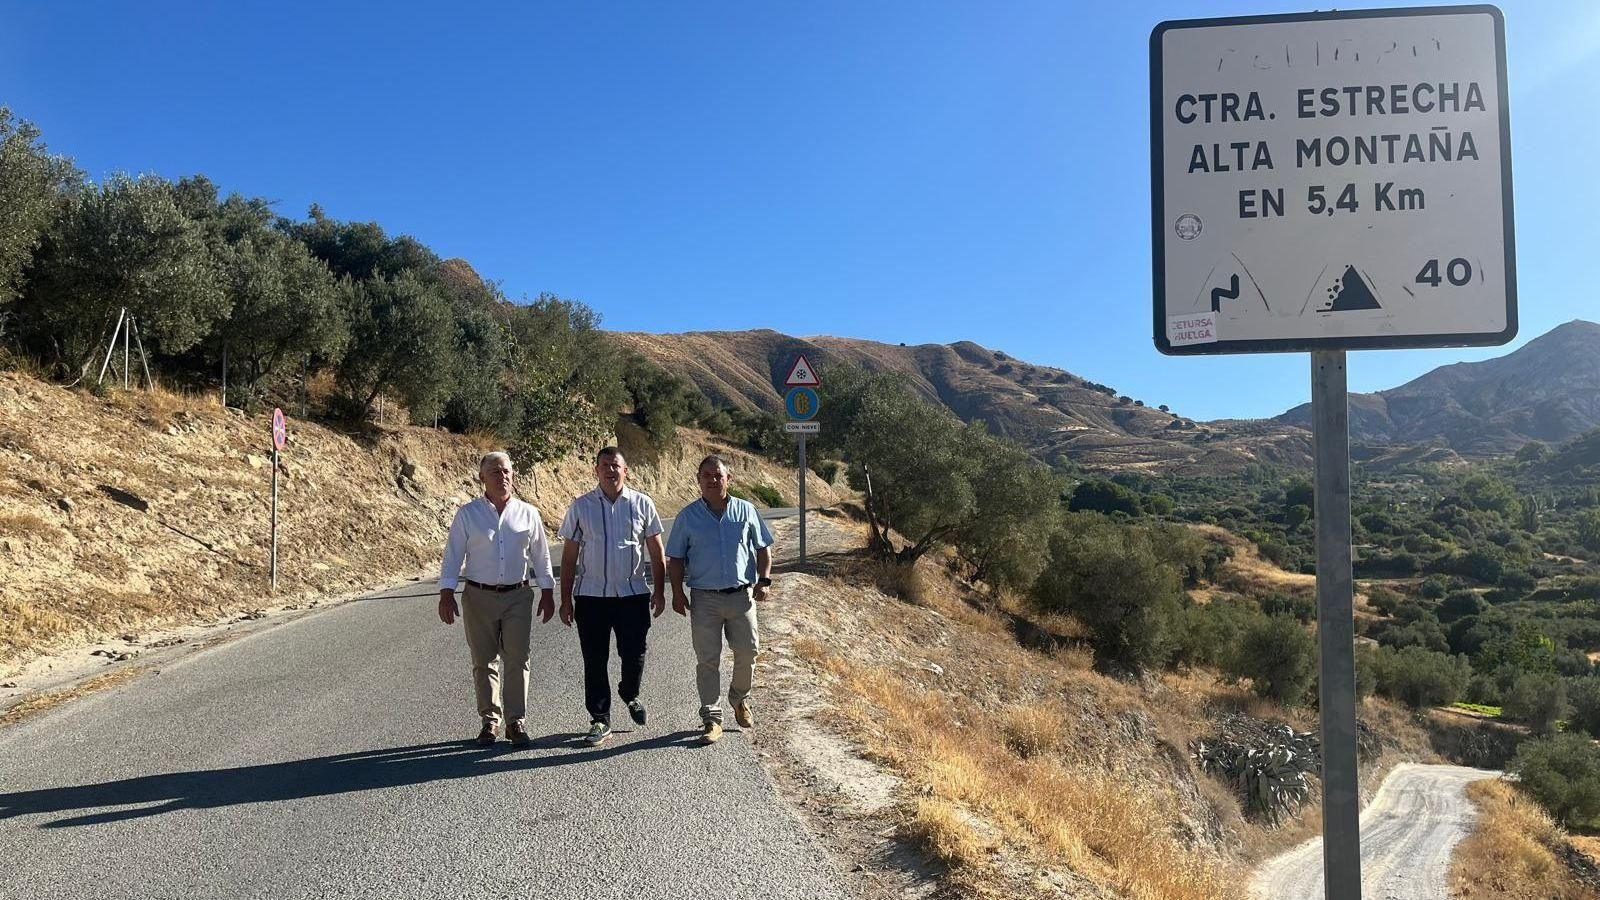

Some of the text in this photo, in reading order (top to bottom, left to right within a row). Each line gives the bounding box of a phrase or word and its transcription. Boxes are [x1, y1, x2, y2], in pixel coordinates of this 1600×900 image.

[1174, 82, 1486, 125] CTRA. ESTRECHA
[1187, 126, 1479, 174] ALTA MONTAÑA
[1238, 181, 1425, 219] EN 5,4 Km
[1415, 257, 1472, 288] 40
